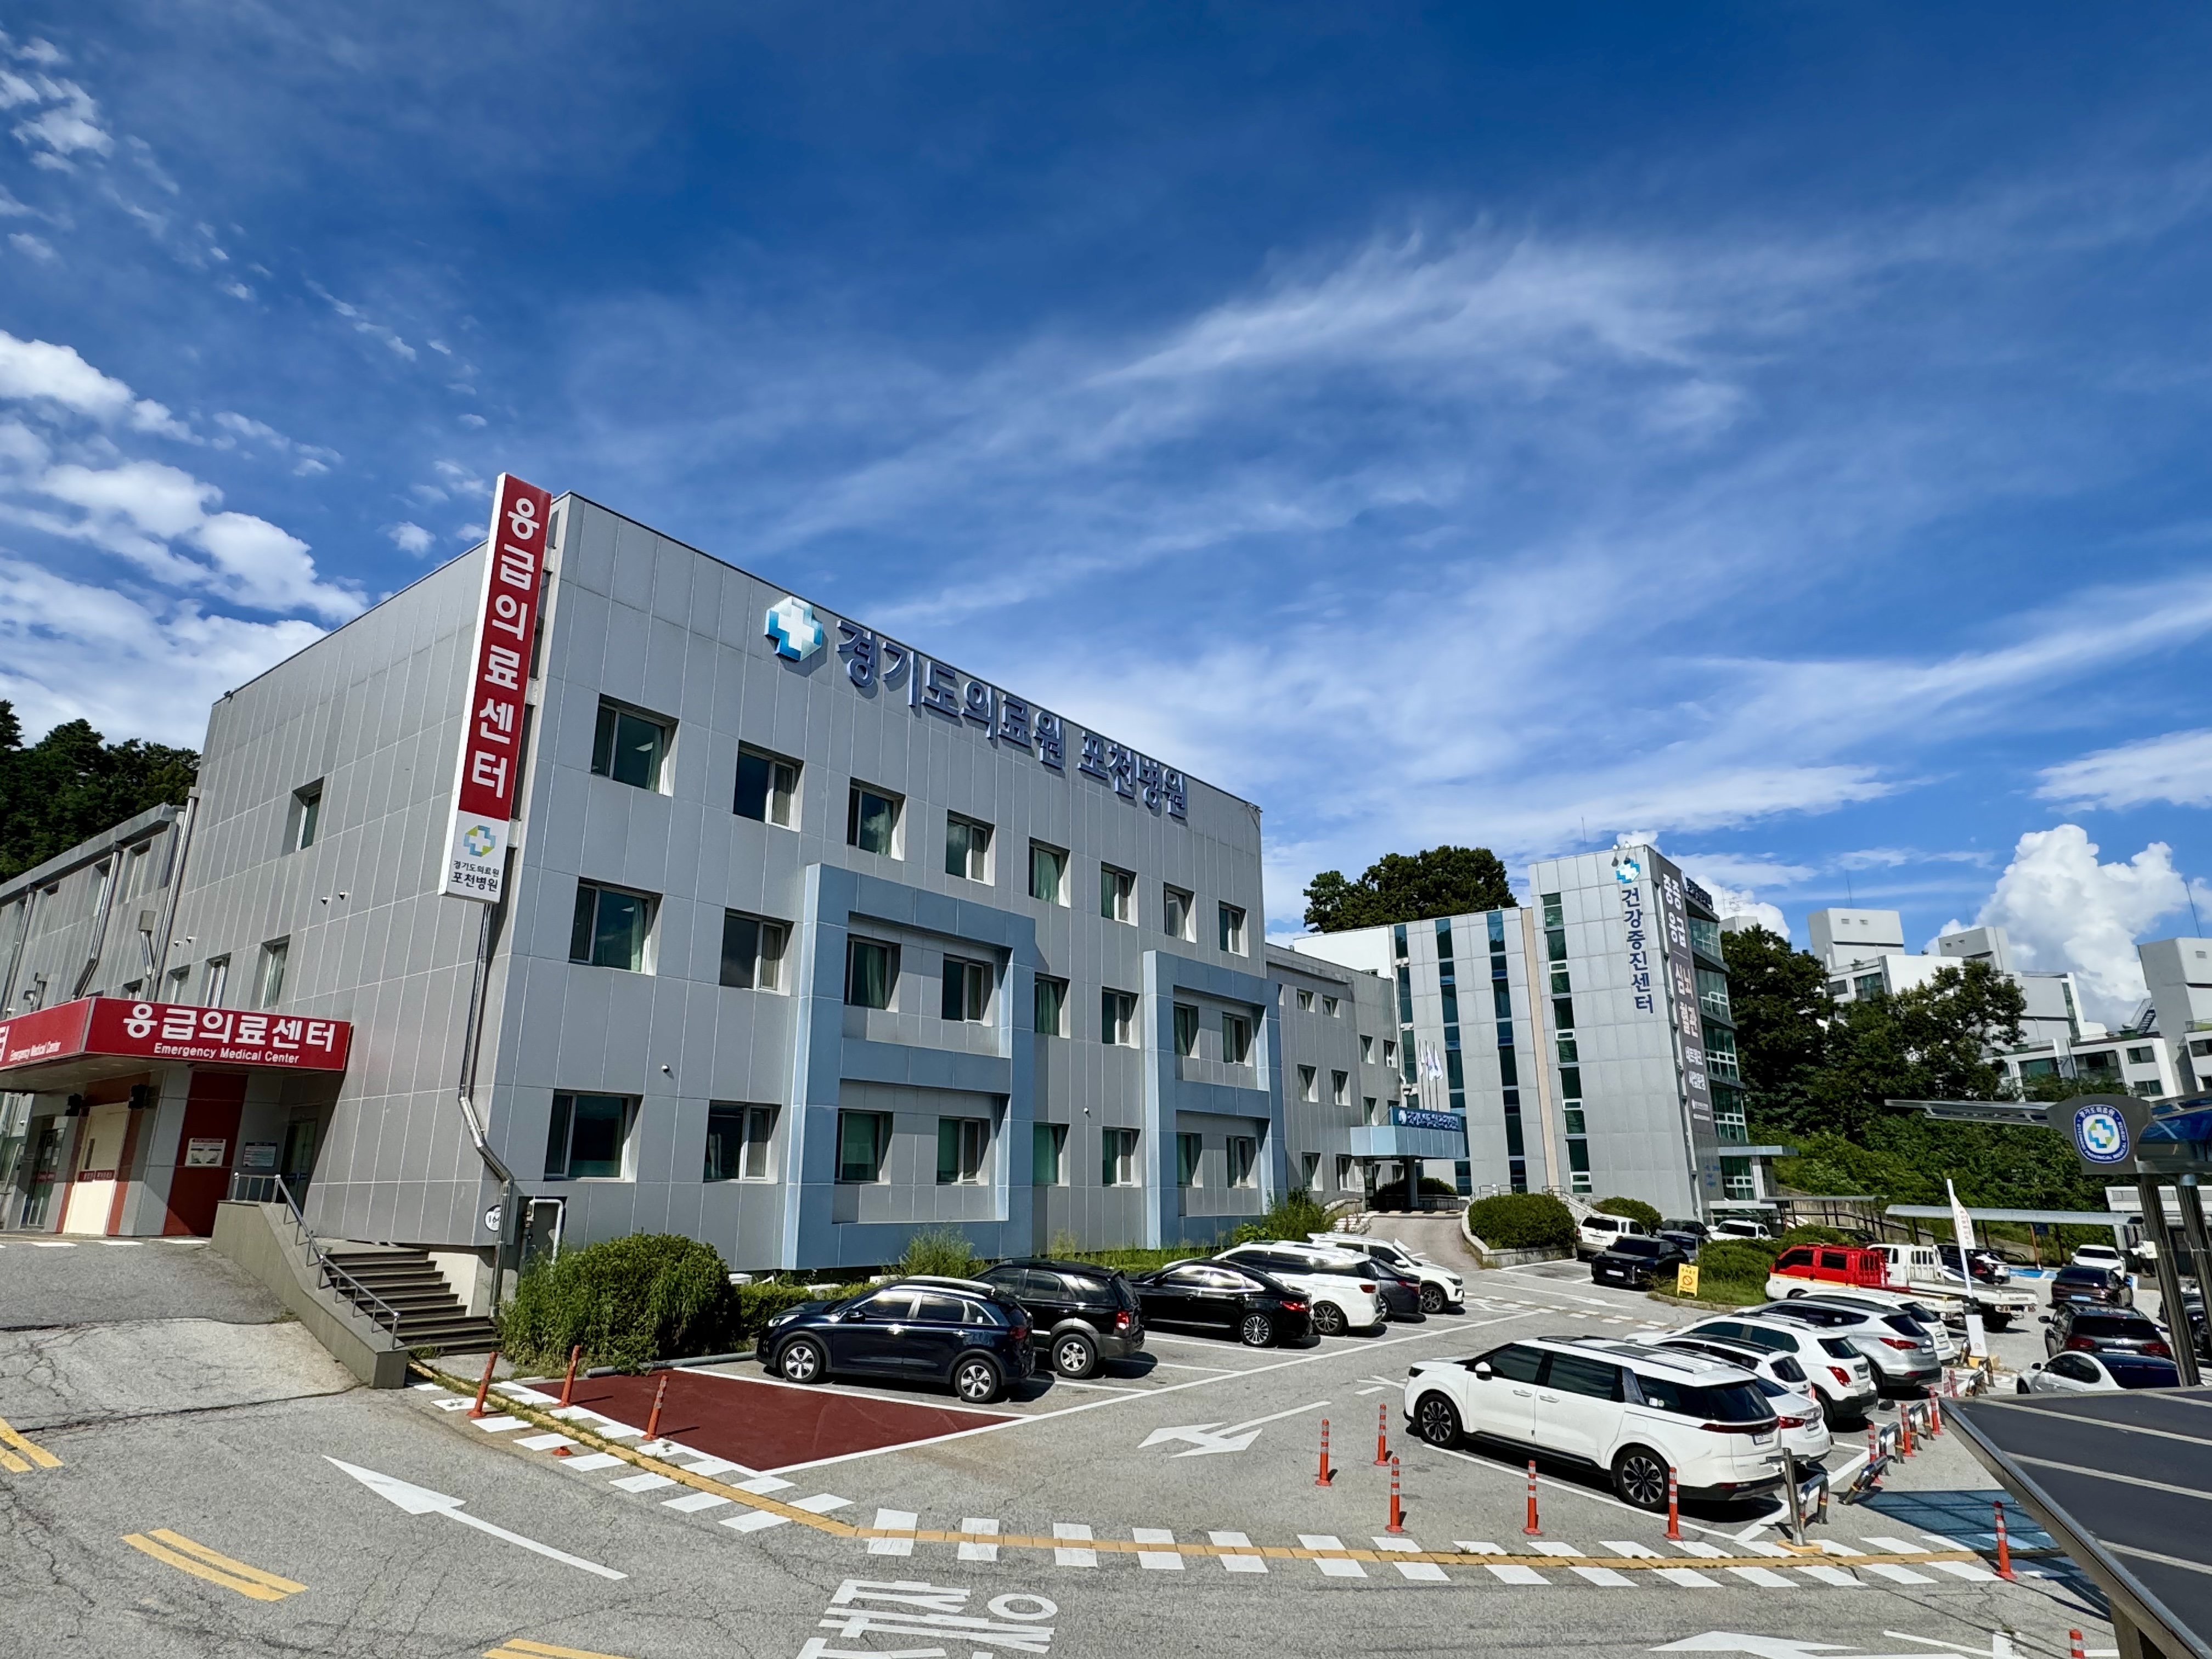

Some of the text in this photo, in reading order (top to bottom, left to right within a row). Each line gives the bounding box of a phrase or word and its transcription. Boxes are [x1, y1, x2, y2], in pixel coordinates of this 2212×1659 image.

[471, 497, 540, 798] 응급의료센터
[837, 619, 1187, 819] 경기도의료원 포천병원
[451, 871, 498, 893] 포천병원
[453, 860, 499, 877] 경기도의료원
[1663, 873, 1682, 911] 중증
[1668, 912, 1686, 949] 응급
[1622, 888, 1654, 1014] 건강증진센터
[123, 1004, 336, 1052] 응급의료센터
[154, 1042, 300, 1064] Emergency Medical Center
